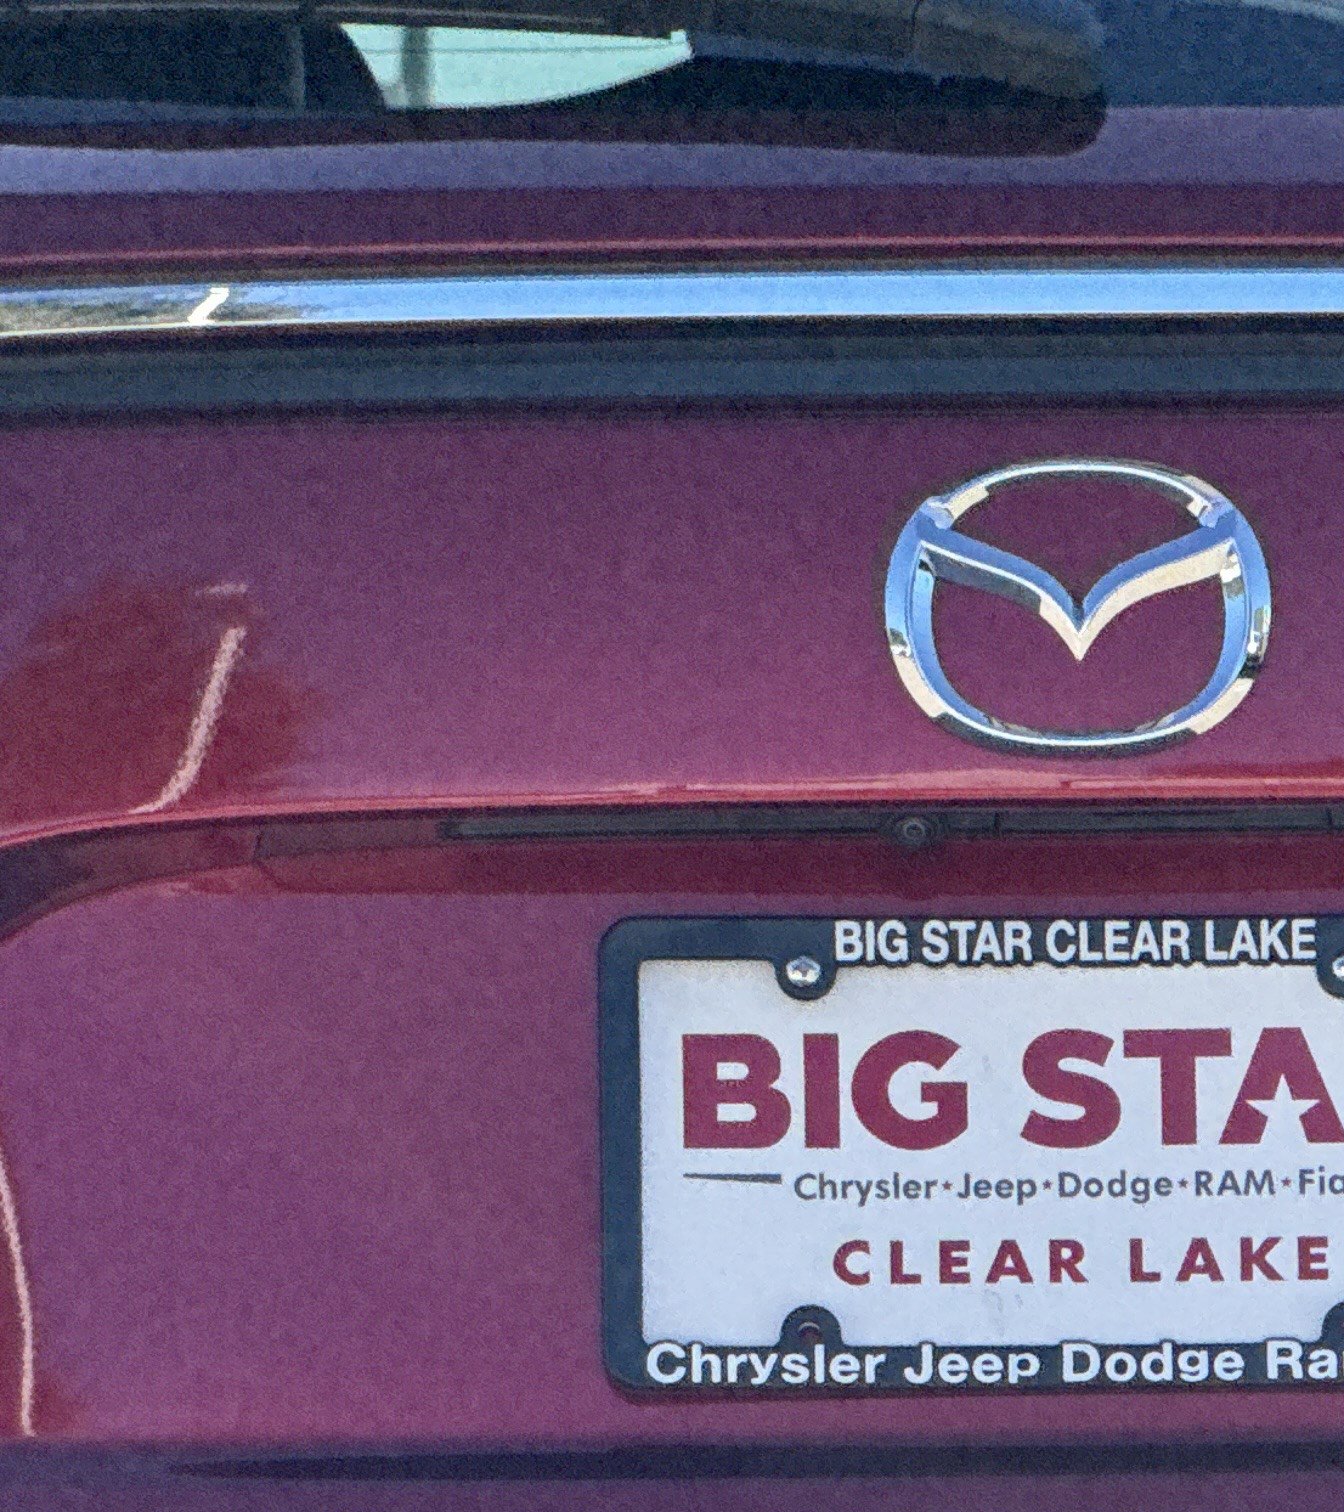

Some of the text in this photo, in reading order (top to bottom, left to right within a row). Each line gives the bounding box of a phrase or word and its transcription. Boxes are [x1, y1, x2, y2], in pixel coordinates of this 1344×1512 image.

[834, 918, 1317, 962] BIG STAR CLEAR LAKE
[681, 1029, 969, 1151] BIG
[793, 1172, 938, 1207] Chrysler
[958, 1171, 1038, 1206] Jeep
[1058, 1169, 1175, 1203] Dodge
[1194, 1169, 1276, 1197] RAM
[832, 1235, 1330, 1286] CLEAR LAKE
[646, 1342, 887, 1385] Chrysler
[904, 1341, 1041, 1384] Jeep
[1062, 1342, 1245, 1383] Dodge
